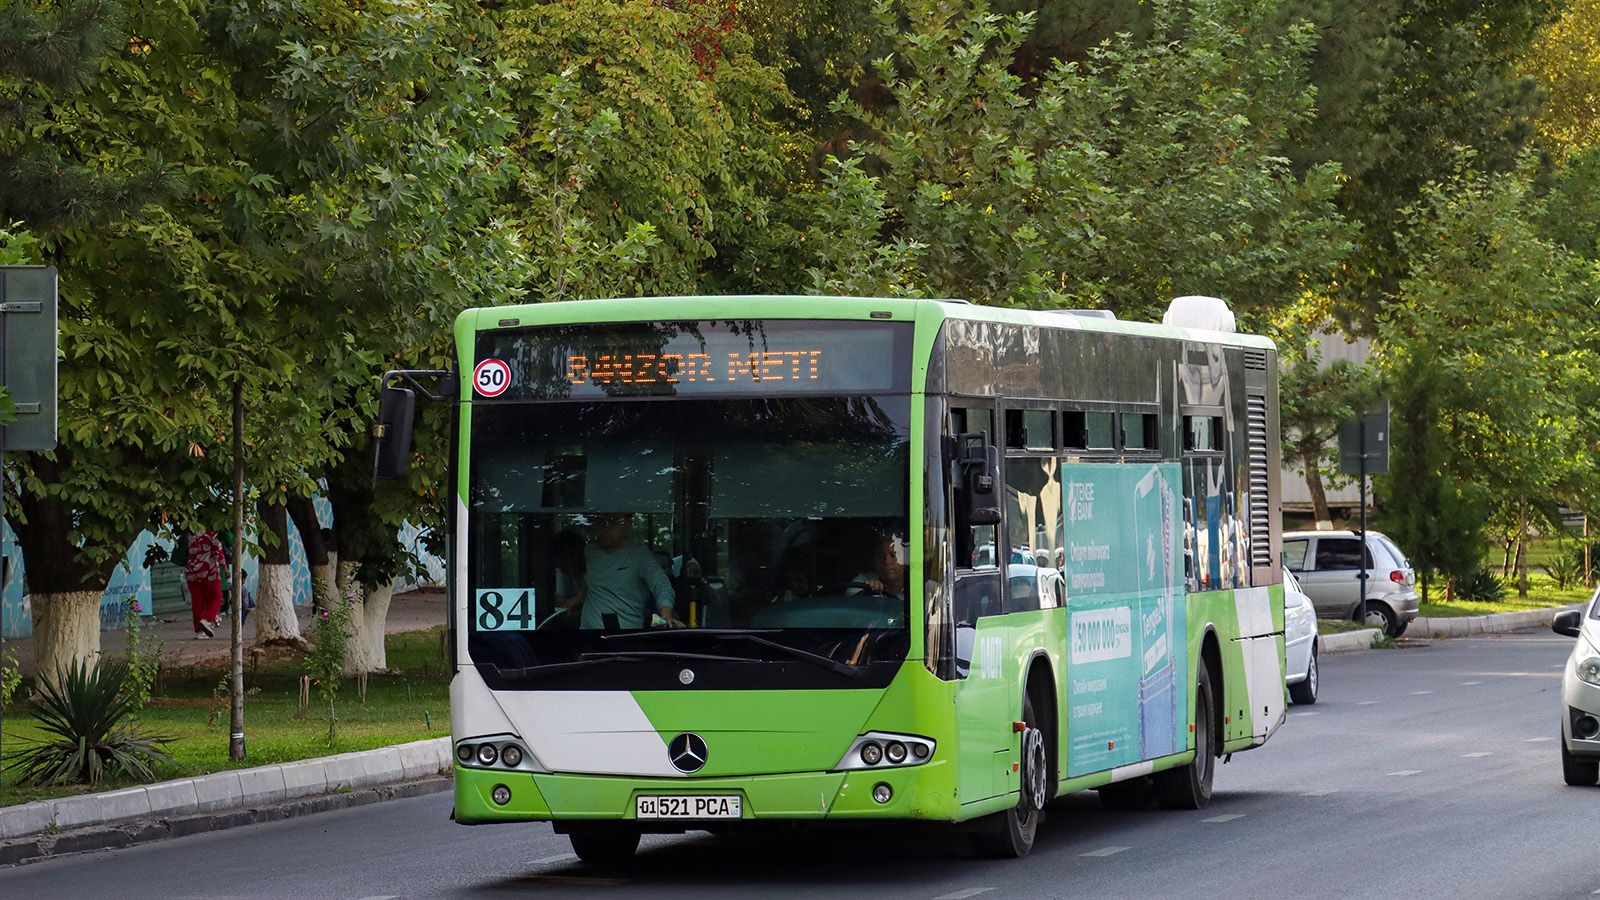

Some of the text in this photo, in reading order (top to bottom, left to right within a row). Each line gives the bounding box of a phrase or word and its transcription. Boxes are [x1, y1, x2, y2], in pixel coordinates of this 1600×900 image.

[479, 369, 504, 386] 50
[1075, 482, 1095, 501] TENGE
[1077, 502, 1094, 520] BANK
[479, 591, 532, 630] 84
[641, 799, 730, 816] 01 521 PCA
